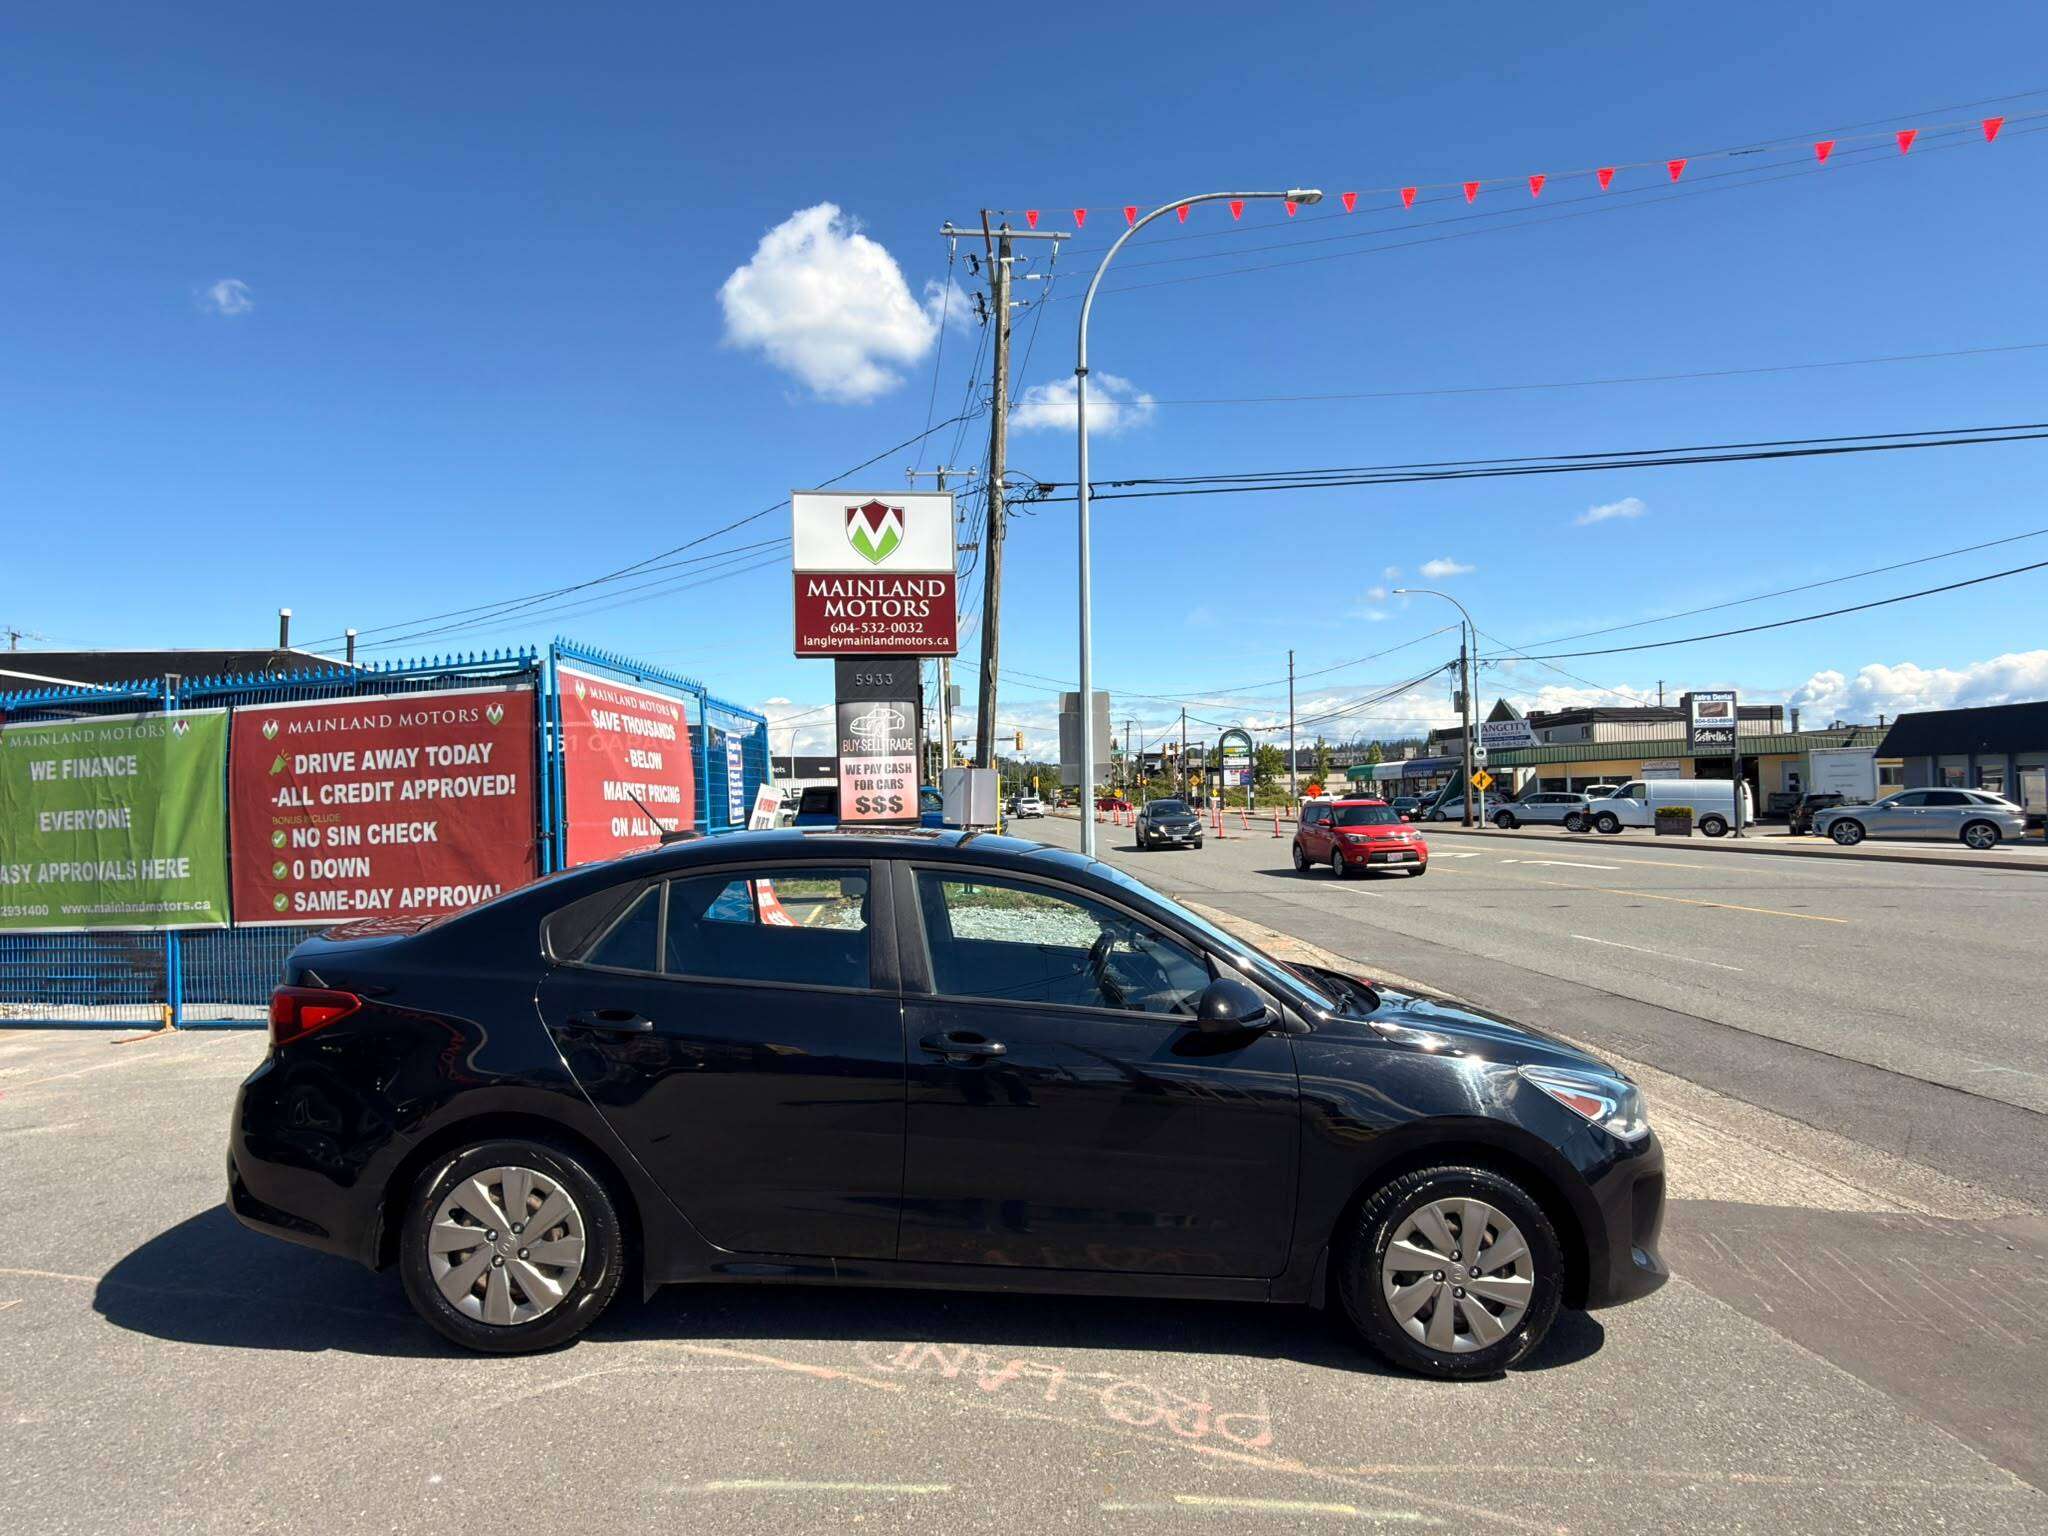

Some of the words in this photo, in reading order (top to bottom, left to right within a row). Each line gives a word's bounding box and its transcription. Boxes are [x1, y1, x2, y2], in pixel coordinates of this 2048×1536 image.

[807, 579, 946, 597] MAINLAND
[824, 599, 930, 617] MOTORS
[830, 622, 924, 634] 604-532-0032
[803, 635, 949, 648] langleymainlandmotors.ca
[856, 673, 894, 686] 5933
[588, 687, 639, 708] MAINLAND
[639, 701, 671, 716] MOTORS
[288, 714, 392, 734] MAINLAND
[399, 708, 479, 728] MOTORS
[591, 708, 621, 733] SAVE
[621, 714, 676, 741] THOUSANDS
[1482, 723, 1528, 732] ANGCITY
[9, 730, 94, 747] MAINLAND
[99, 725, 166, 741] MOTORS
[30, 760, 56, 781] WE
[62, 755, 138, 779] FINANCE
[295, 751, 356, 774] DRIVE
[361, 747, 420, 771] AWAY
[425, 742, 494, 767] TODAY
[845, 764, 862, 775] WE
[864, 763, 882, 775] PAY
[884, 763, 912, 774] CASH
[271, 786, 314, 808] -ALL
[320, 781, 394, 806] CREDIT
[400, 774, 517, 801] APPROVED!
[603, 781, 646, 802] MARKET
[648, 784, 680, 803] PRICING
[854, 779, 874, 791] FOR
[876, 778, 904, 790] CARS
[856, 795, 904, 815] $$$
[40, 808, 131, 832] EVERYONE
[272, 815, 302, 825] BONUS
[611, 817, 628, 837] ON
[631, 817, 649, 836] ALL
[292, 828, 321, 848] NO
[327, 825, 361, 847] SIN
[367, 821, 438, 845] CHECK
[38, 860, 136, 883] APPROVALS
[141, 857, 190, 880] HERE
[310, 857, 370, 880] DOWN
[61, 900, 211, 914] www.mainlandmotors.ca
[294, 888, 394, 912] SAME-DAY
